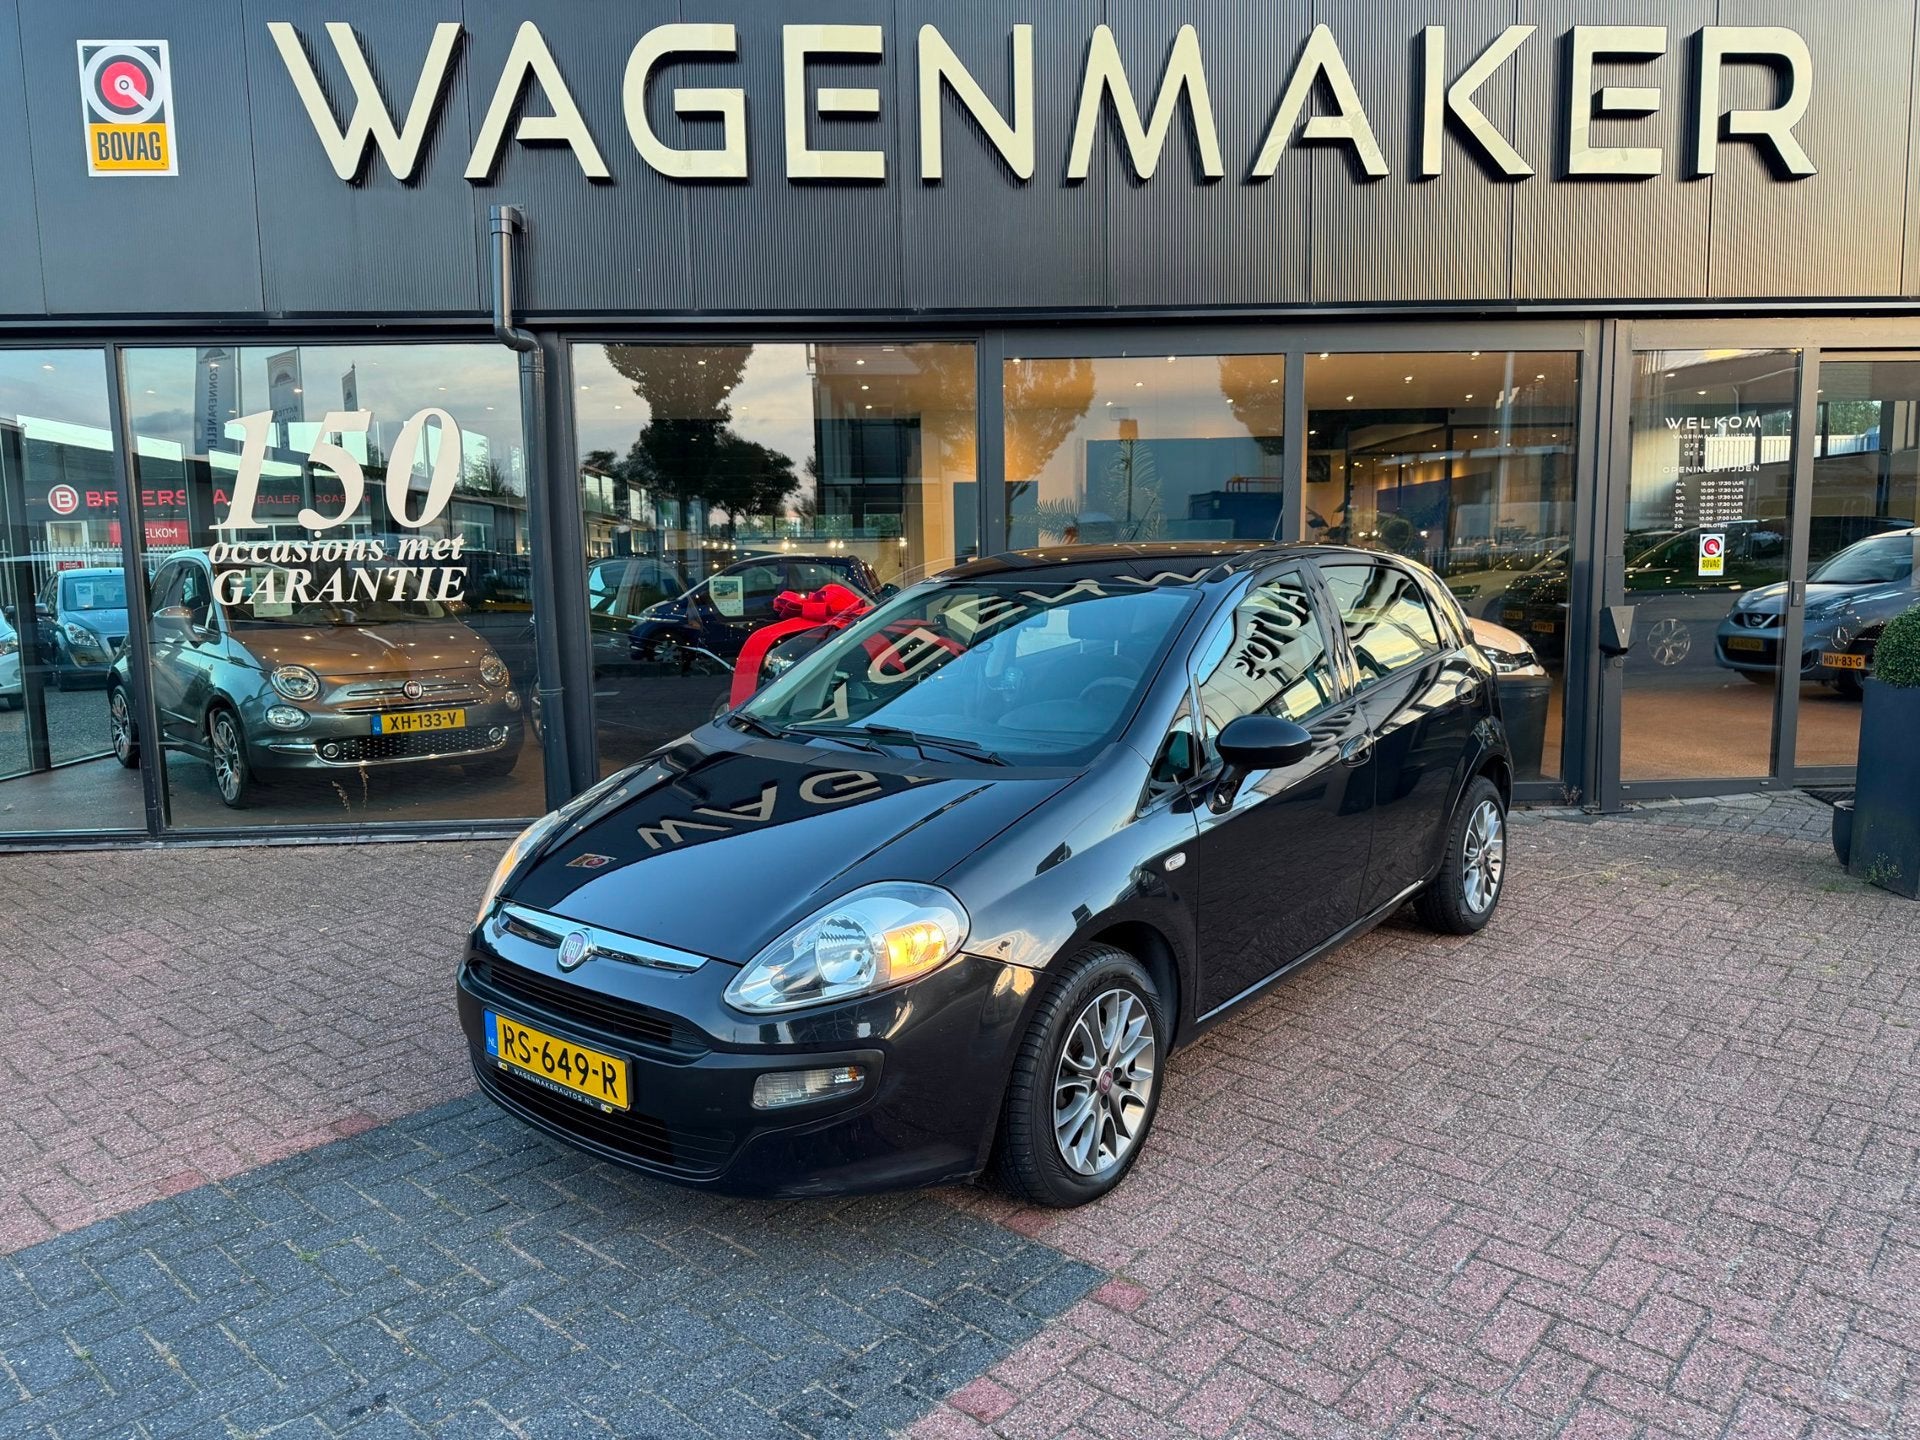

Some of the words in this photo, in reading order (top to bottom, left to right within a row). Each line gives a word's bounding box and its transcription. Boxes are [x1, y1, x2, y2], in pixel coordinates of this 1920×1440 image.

[267, 21, 1817, 182] WAGENMAKER
[96, 131, 162, 161] BOVAG
[1664, 415, 1761, 430] WELKOM
[208, 407, 463, 530] 150
[257, 494, 300, 504] EALER
[145, 527, 178, 539] ELKOM
[208, 530, 384, 564] occasions
[397, 533, 465, 562] met
[1702, 559, 1720, 568] BOVAG
[212, 566, 468, 606] GARANTIE
[1824, 654, 1862, 667] HDV-83-G
[389, 712, 457, 731] XH-133-V
[487, 1036, 497, 1048] NL
[503, 1023, 619, 1099] RS-649-R
[513, 1068, 594, 1106] WAGENMAKERAUTOS.NL
